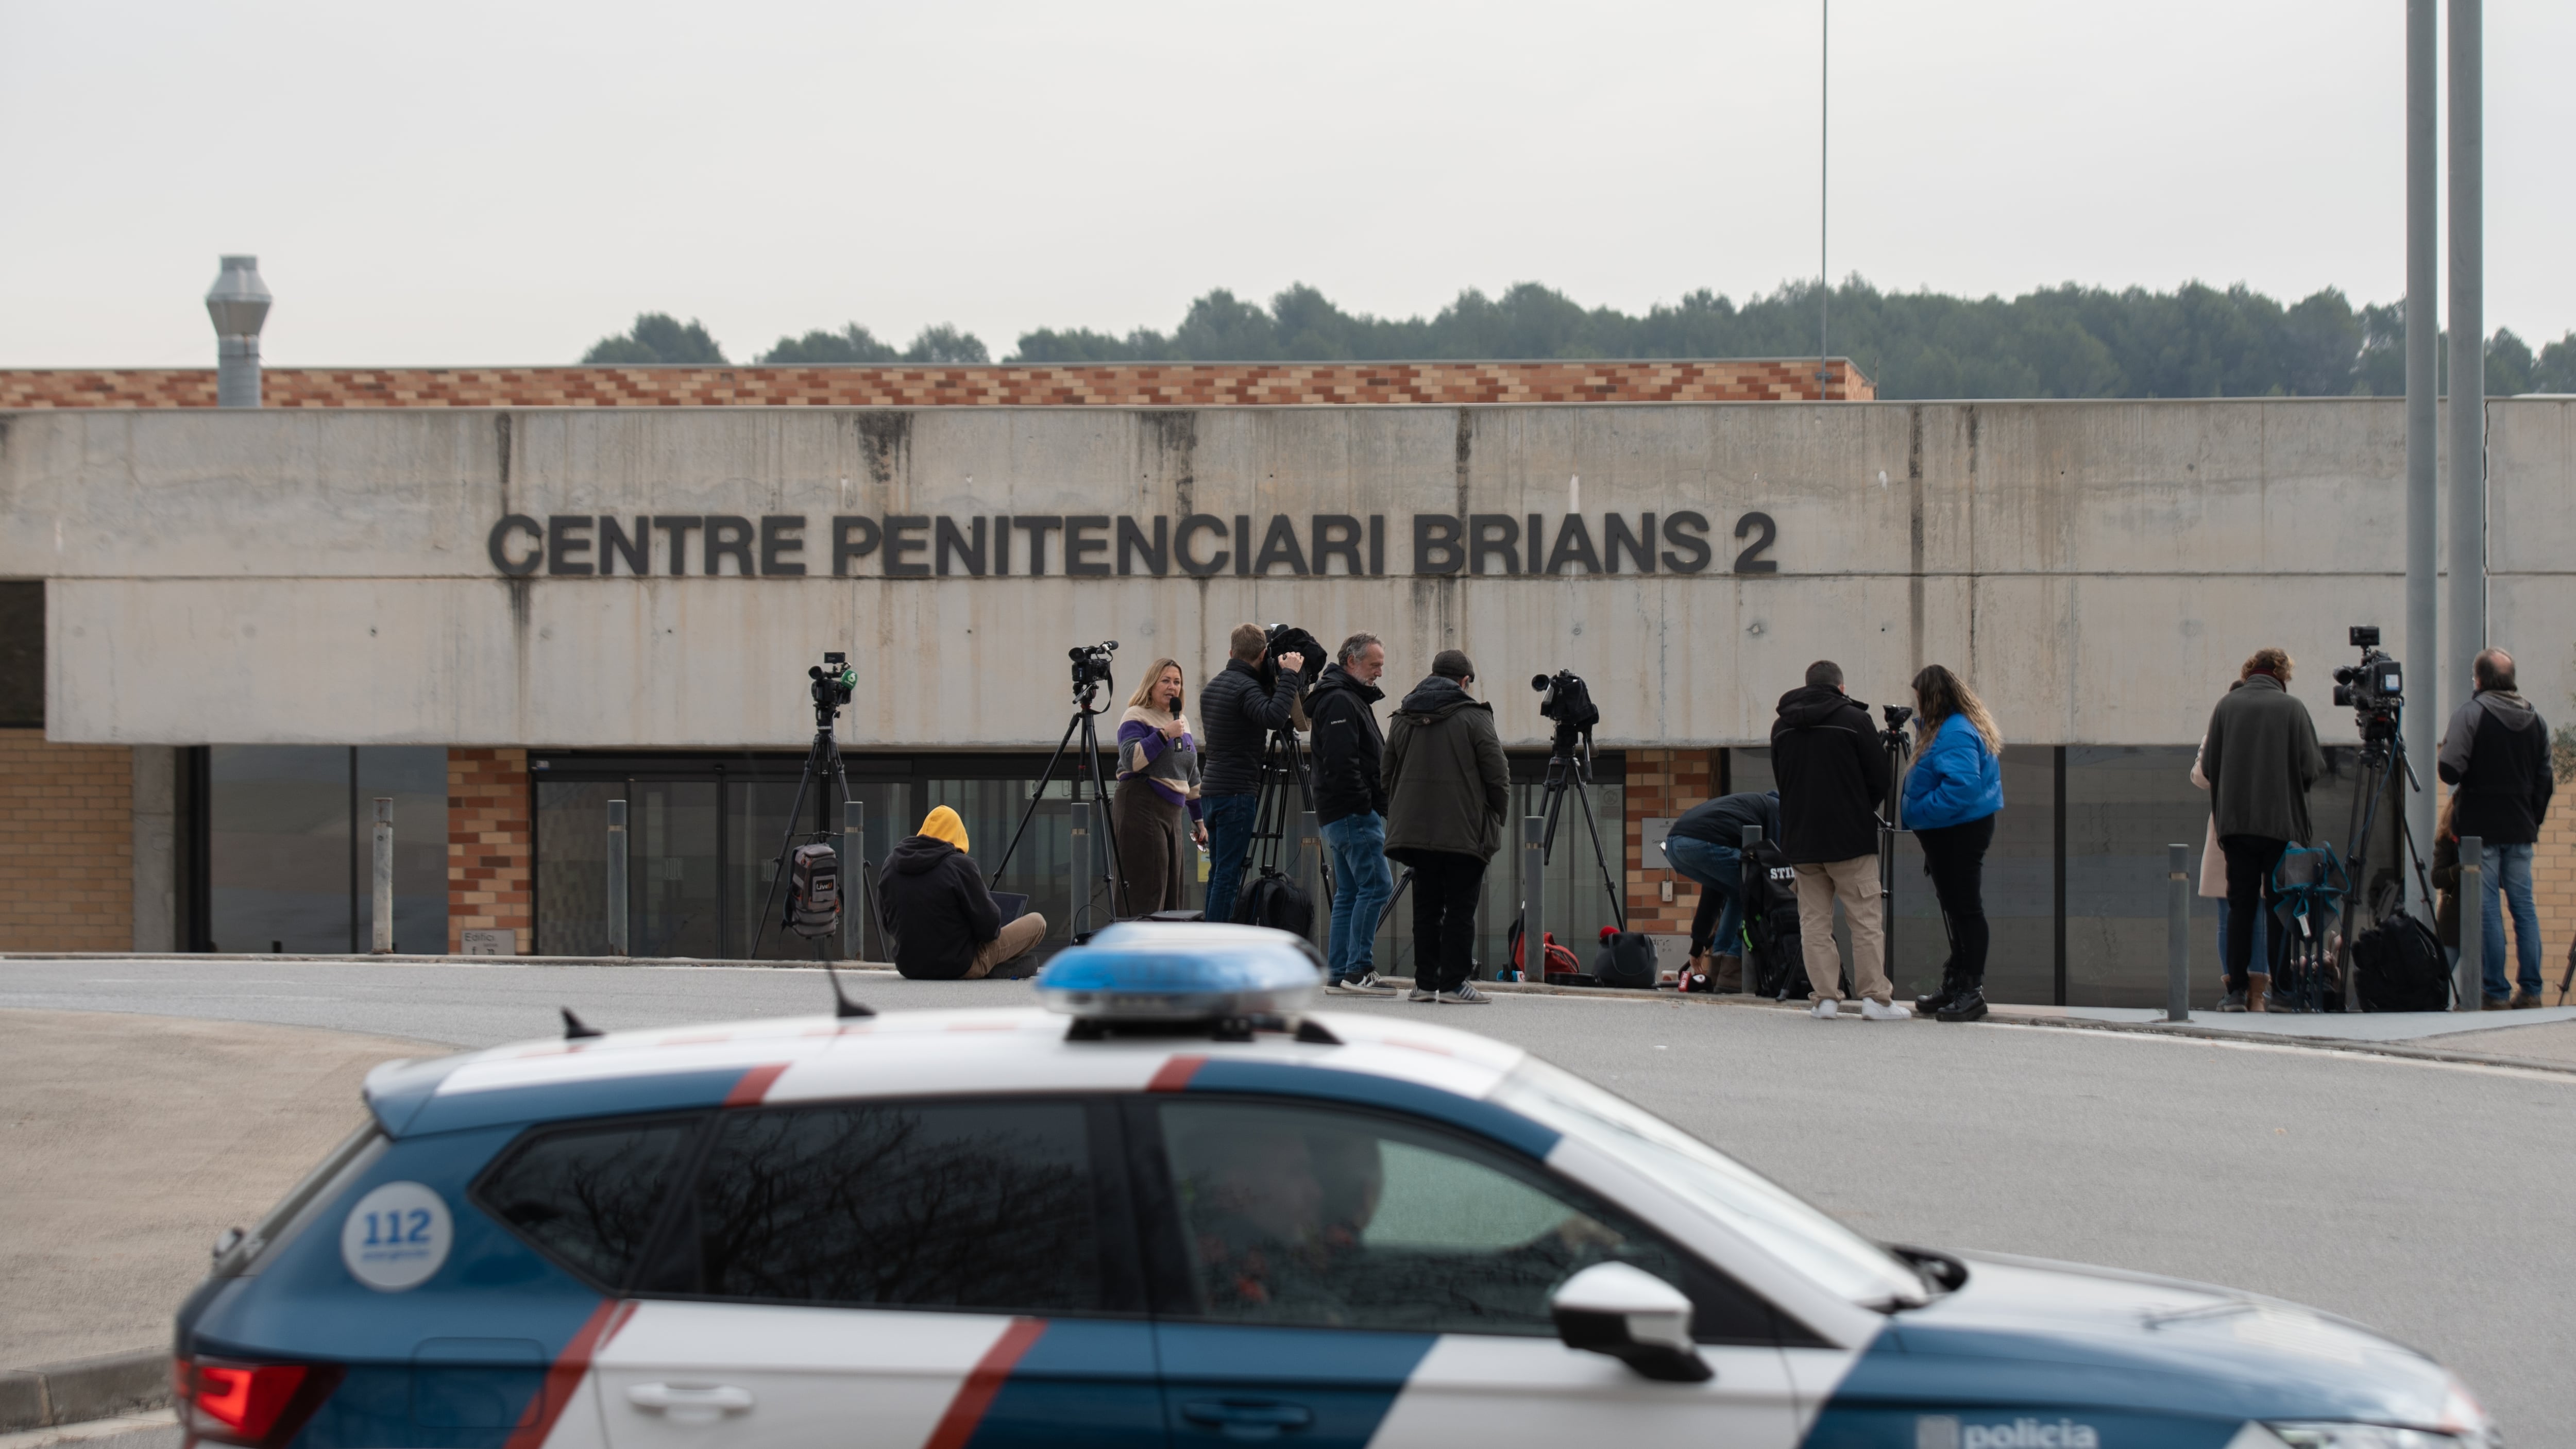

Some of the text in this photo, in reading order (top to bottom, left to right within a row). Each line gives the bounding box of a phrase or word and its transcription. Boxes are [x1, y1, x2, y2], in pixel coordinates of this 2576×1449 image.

[488, 511, 1777, 576] CENTRE PENITENCIARI BRIANS 2
[362, 1207, 432, 1245] 112
[1963, 1417, 2098, 1449] policia
